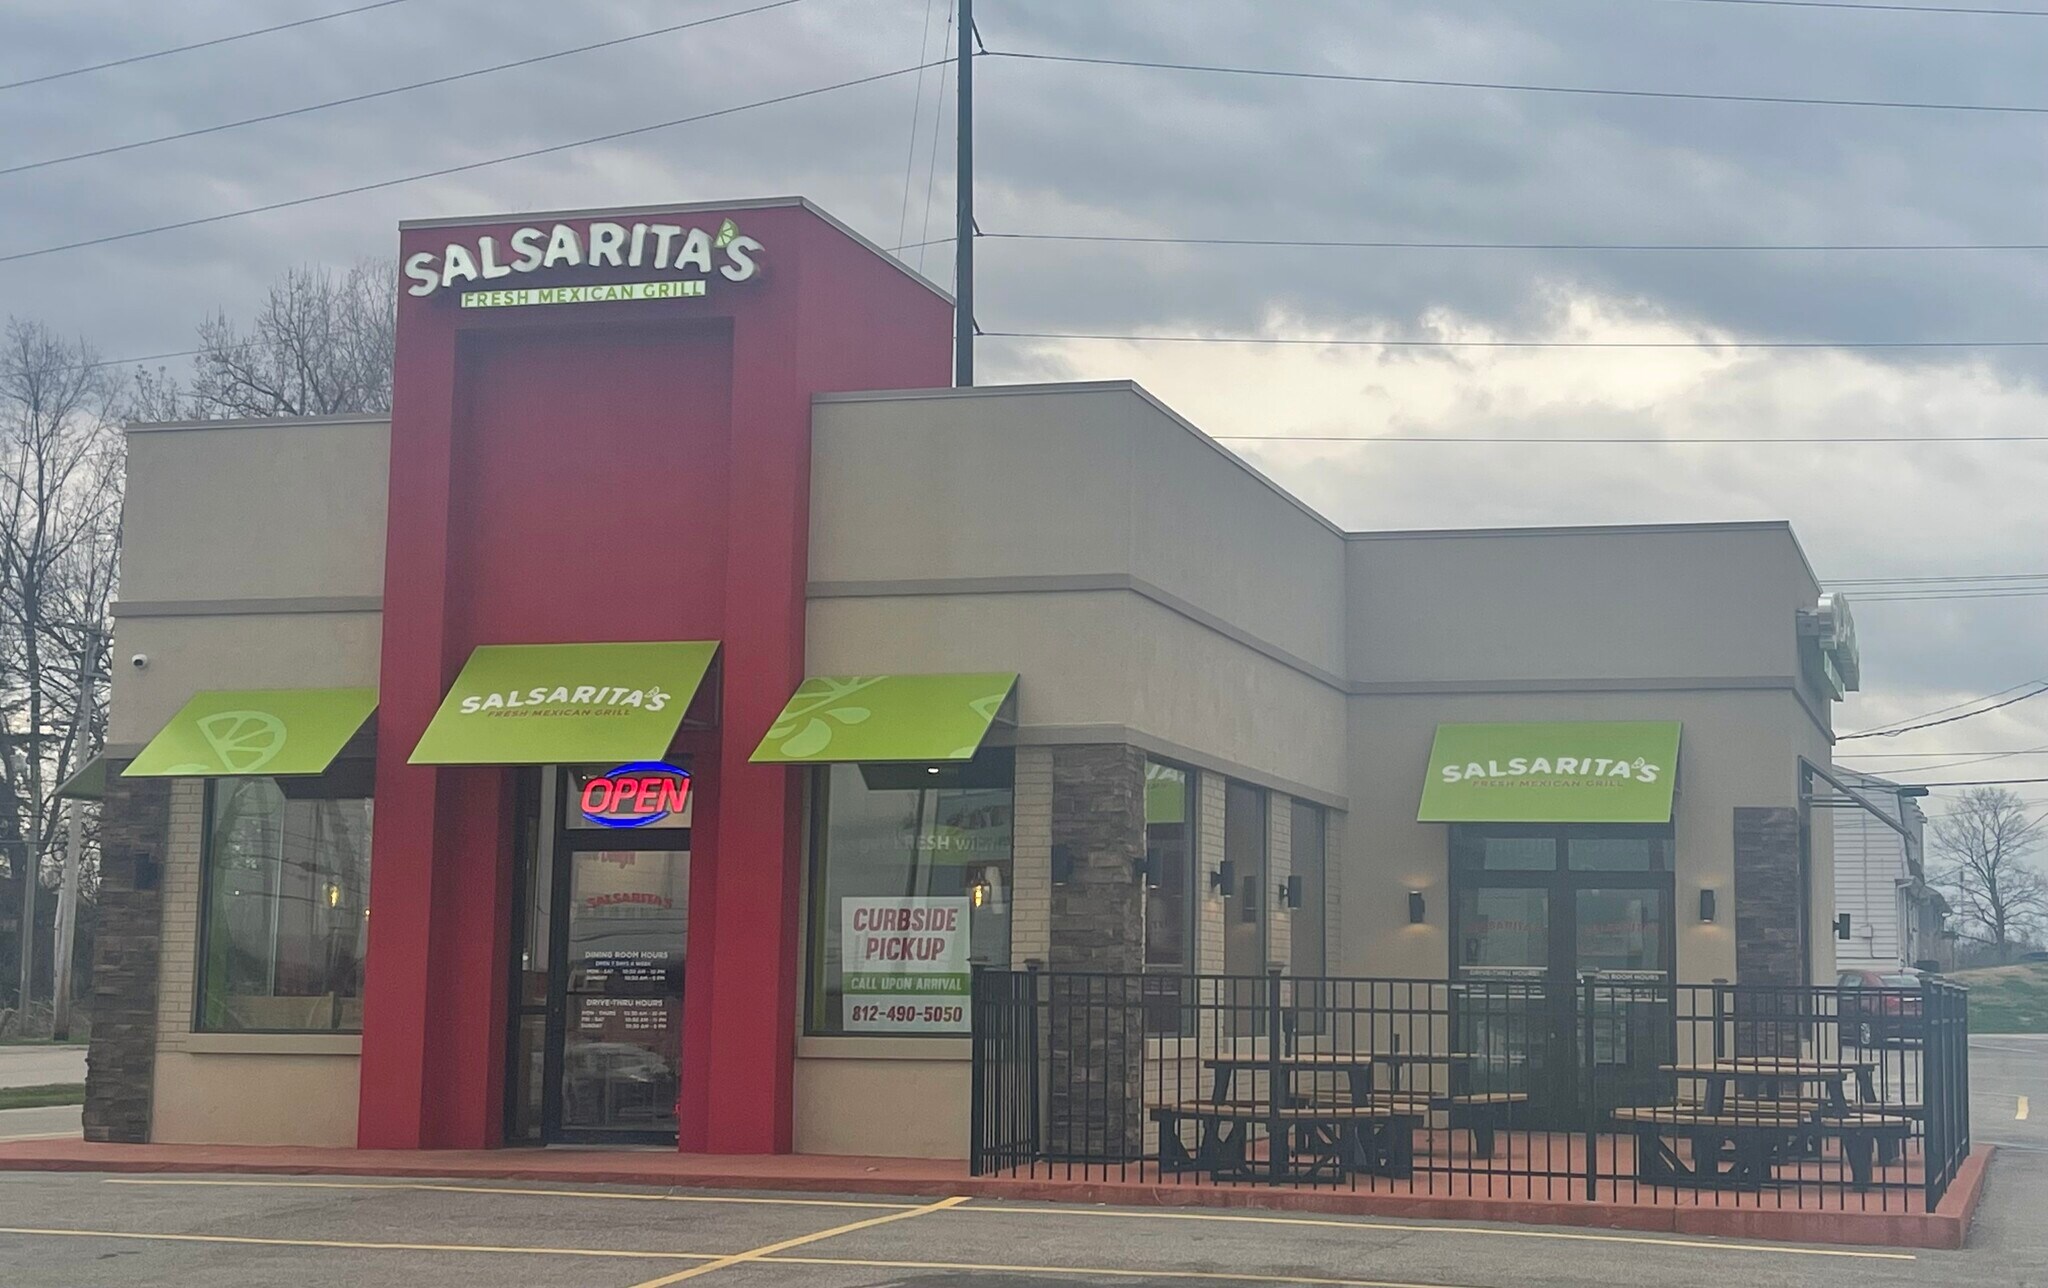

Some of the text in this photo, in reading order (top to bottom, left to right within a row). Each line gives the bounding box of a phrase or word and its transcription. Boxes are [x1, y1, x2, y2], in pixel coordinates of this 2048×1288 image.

[404, 219, 765, 297] SALSARITA'S
[464, 281, 702, 307] FRESH MEXICAN GRILL
[460, 686, 672, 714] SALSARITA'S
[487, 708, 631, 718] FRESH MEXICAN GRILL
[1441, 757, 1661, 783] SALSARITA'S
[1518, 780, 1580, 788] MEXICAN
[581, 777, 690, 813] OPEN
[585, 892, 673, 910] SALSARITAS
[853, 908, 958, 931] CURBSIDE
[585, 951, 668, 959] DINING ROOM HOURS
[865, 937, 946, 961] PICKUP
[851, 977, 962, 991] CALL UPON ARRIVAL
[635, 999, 663, 1007] HOURS
[852, 1005, 963, 1023] 812-490-5050
